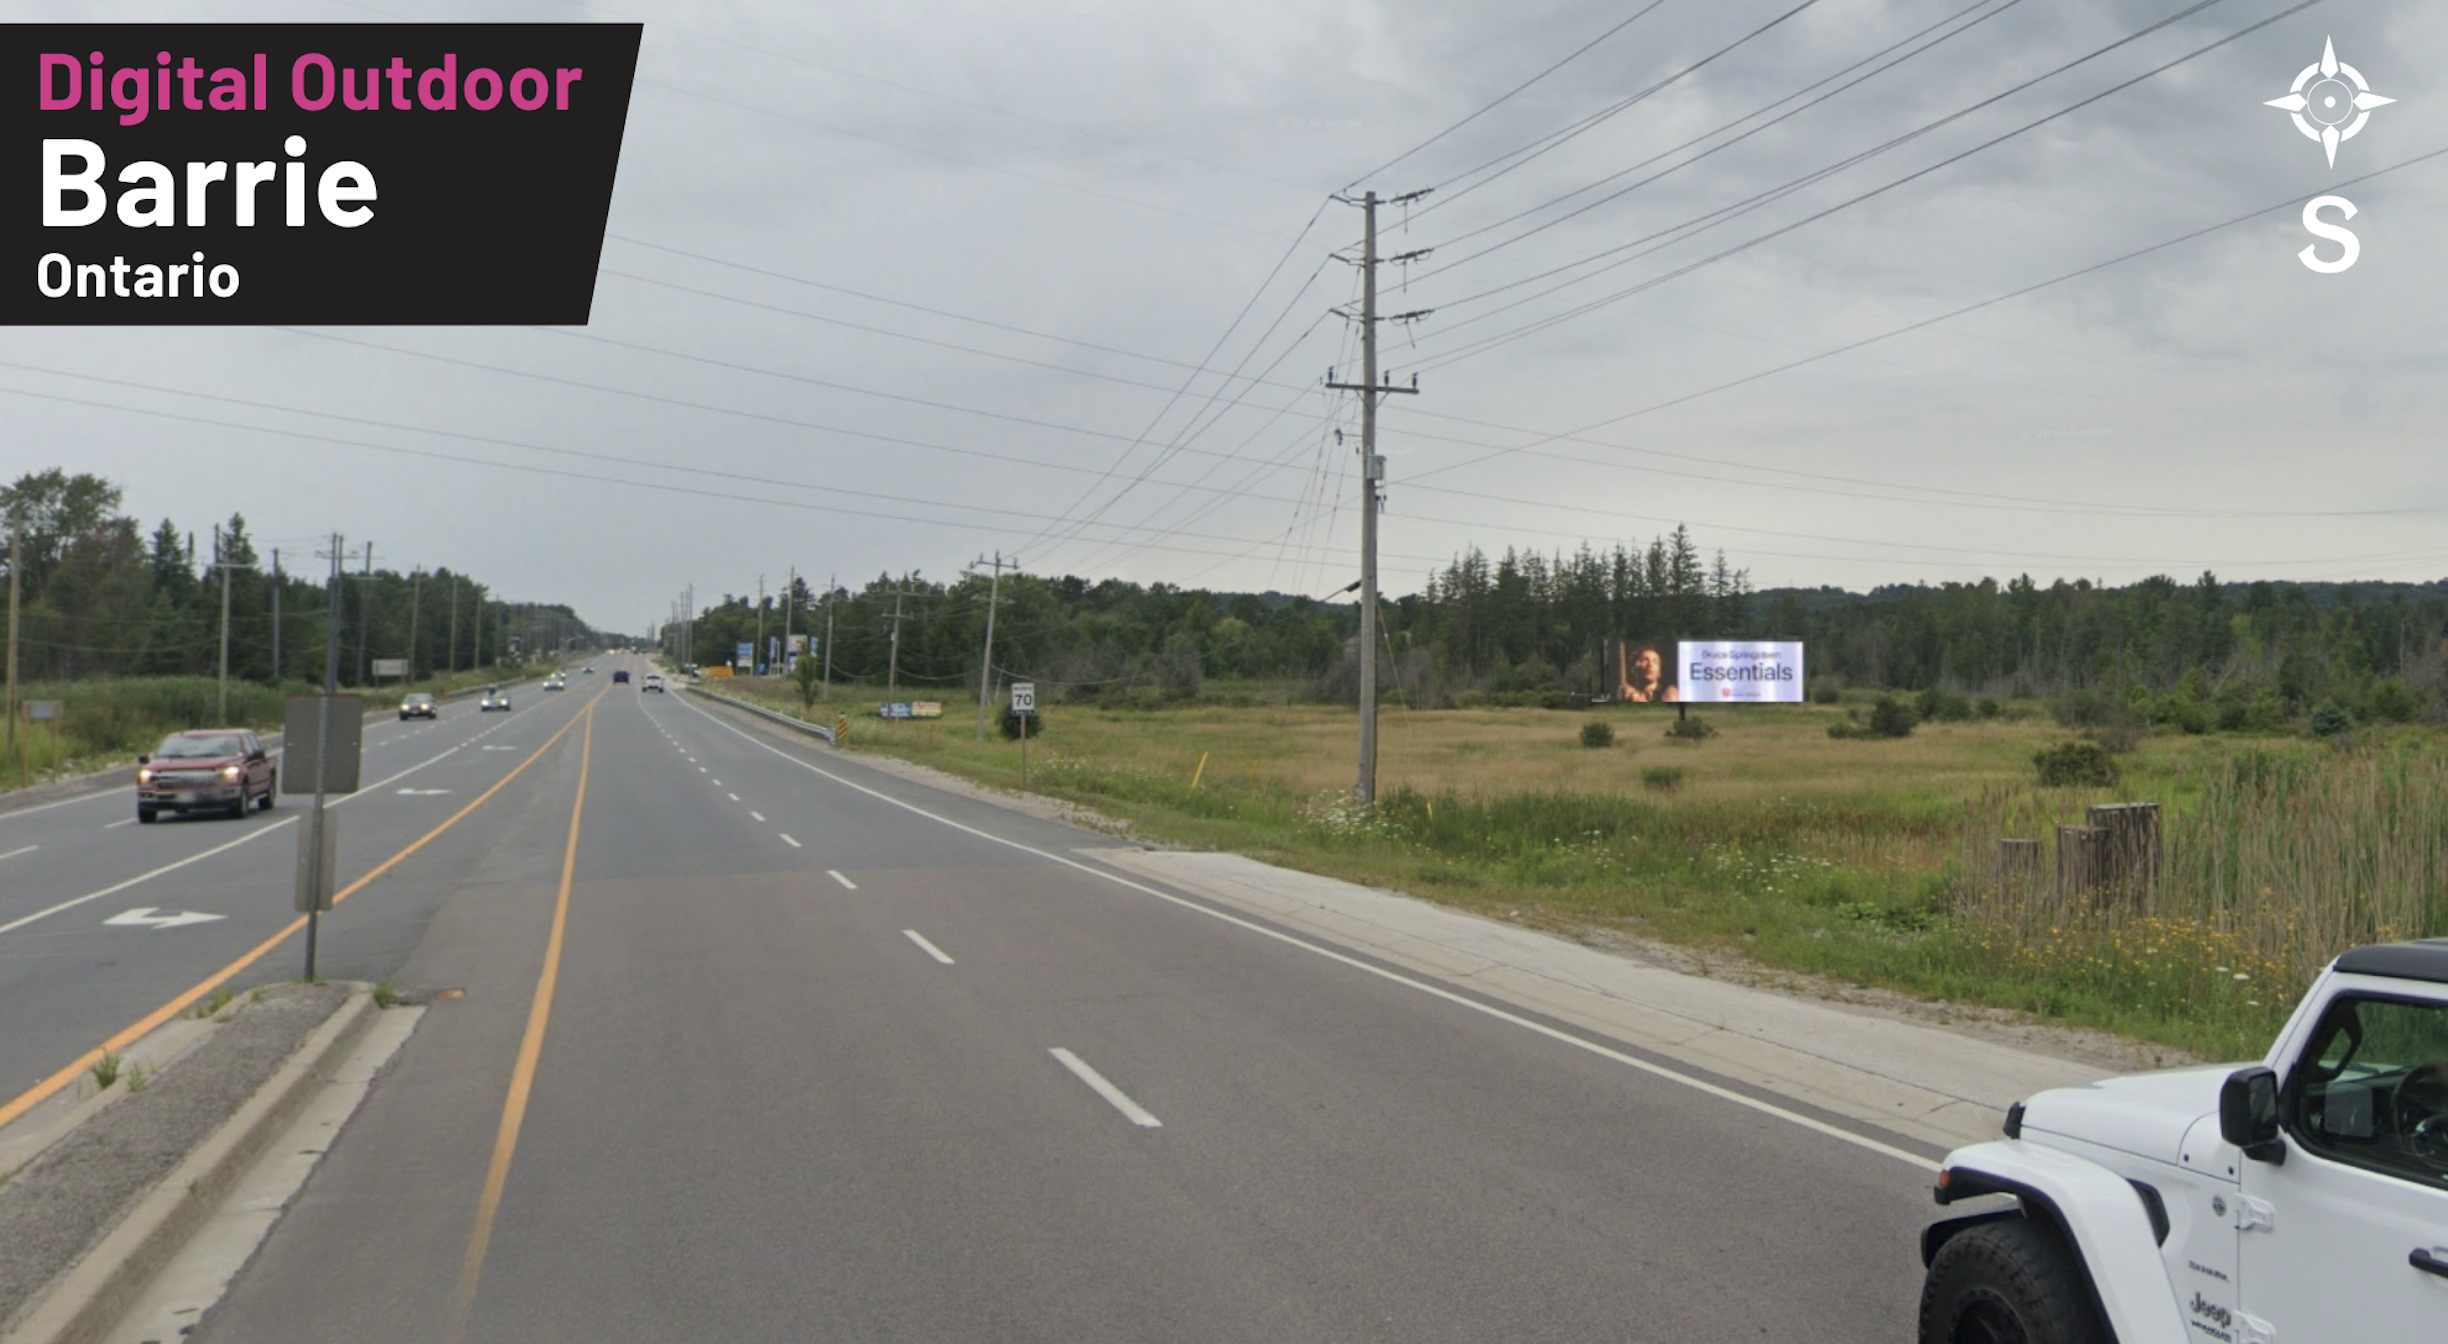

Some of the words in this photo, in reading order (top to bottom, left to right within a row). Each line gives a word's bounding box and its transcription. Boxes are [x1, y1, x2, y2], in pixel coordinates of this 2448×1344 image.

[1690, 662, 1793, 681] Essentials
[1014, 694, 1032, 706] 70
[2190, 1291, 2232, 1329] Jeep
